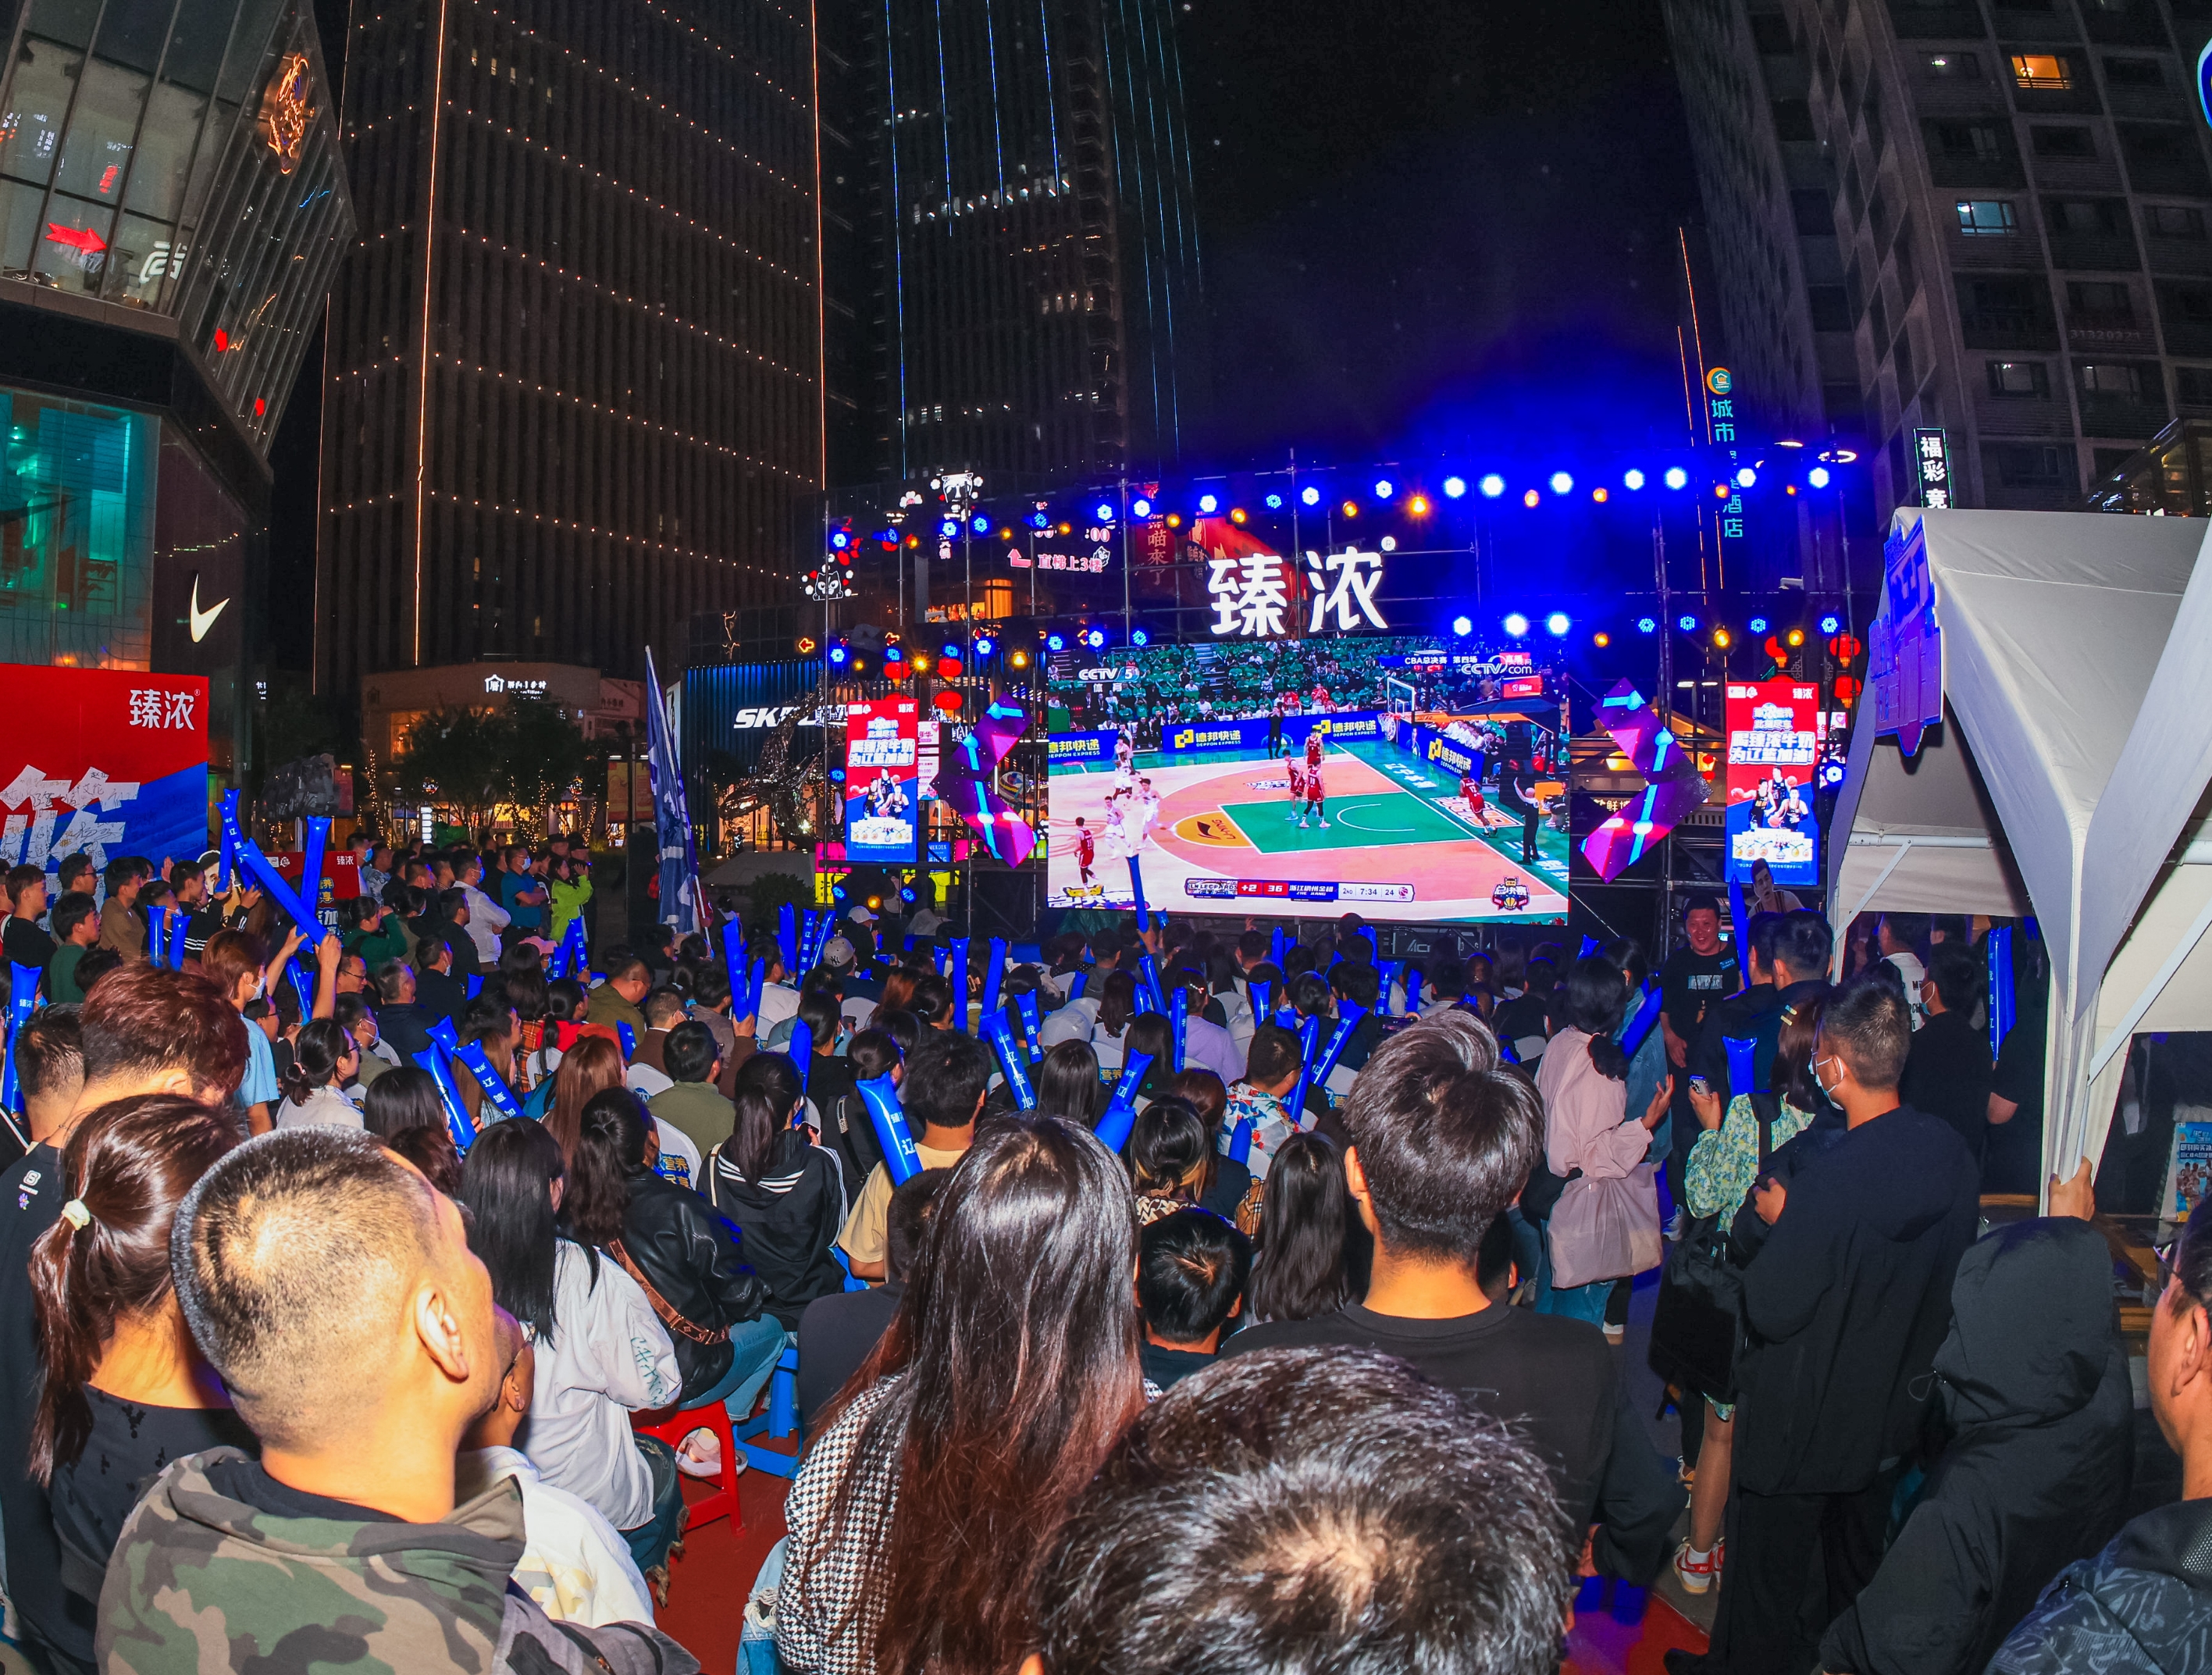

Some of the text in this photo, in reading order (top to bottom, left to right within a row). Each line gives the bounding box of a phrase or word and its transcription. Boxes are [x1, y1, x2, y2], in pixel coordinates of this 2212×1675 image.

[1711, 399, 1744, 538] 城市酒店
[1037, 553, 1103, 574] 直梯上3楼
[1207, 545, 1389, 638] 臻浓
[1452, 654, 1478, 664] 第四场
[1078, 667, 1118, 681] CCTV
[1093, 682, 1123, 693] 体育
[129, 688, 195, 731] 臻浓
[1332, 720, 1377, 733] 德邦快递
[1195, 730, 1241, 743] 德邦快递
[1729, 747, 1814, 764] 为辽篮加油!
[337, 855, 354, 866] 臻浓
[1360, 887, 1377, 896] 7:34
[1026, 1025, 1041, 1055] 我爱
[900, 1137, 916, 1156] 辽
[663, 1155, 689, 1174] 营养
